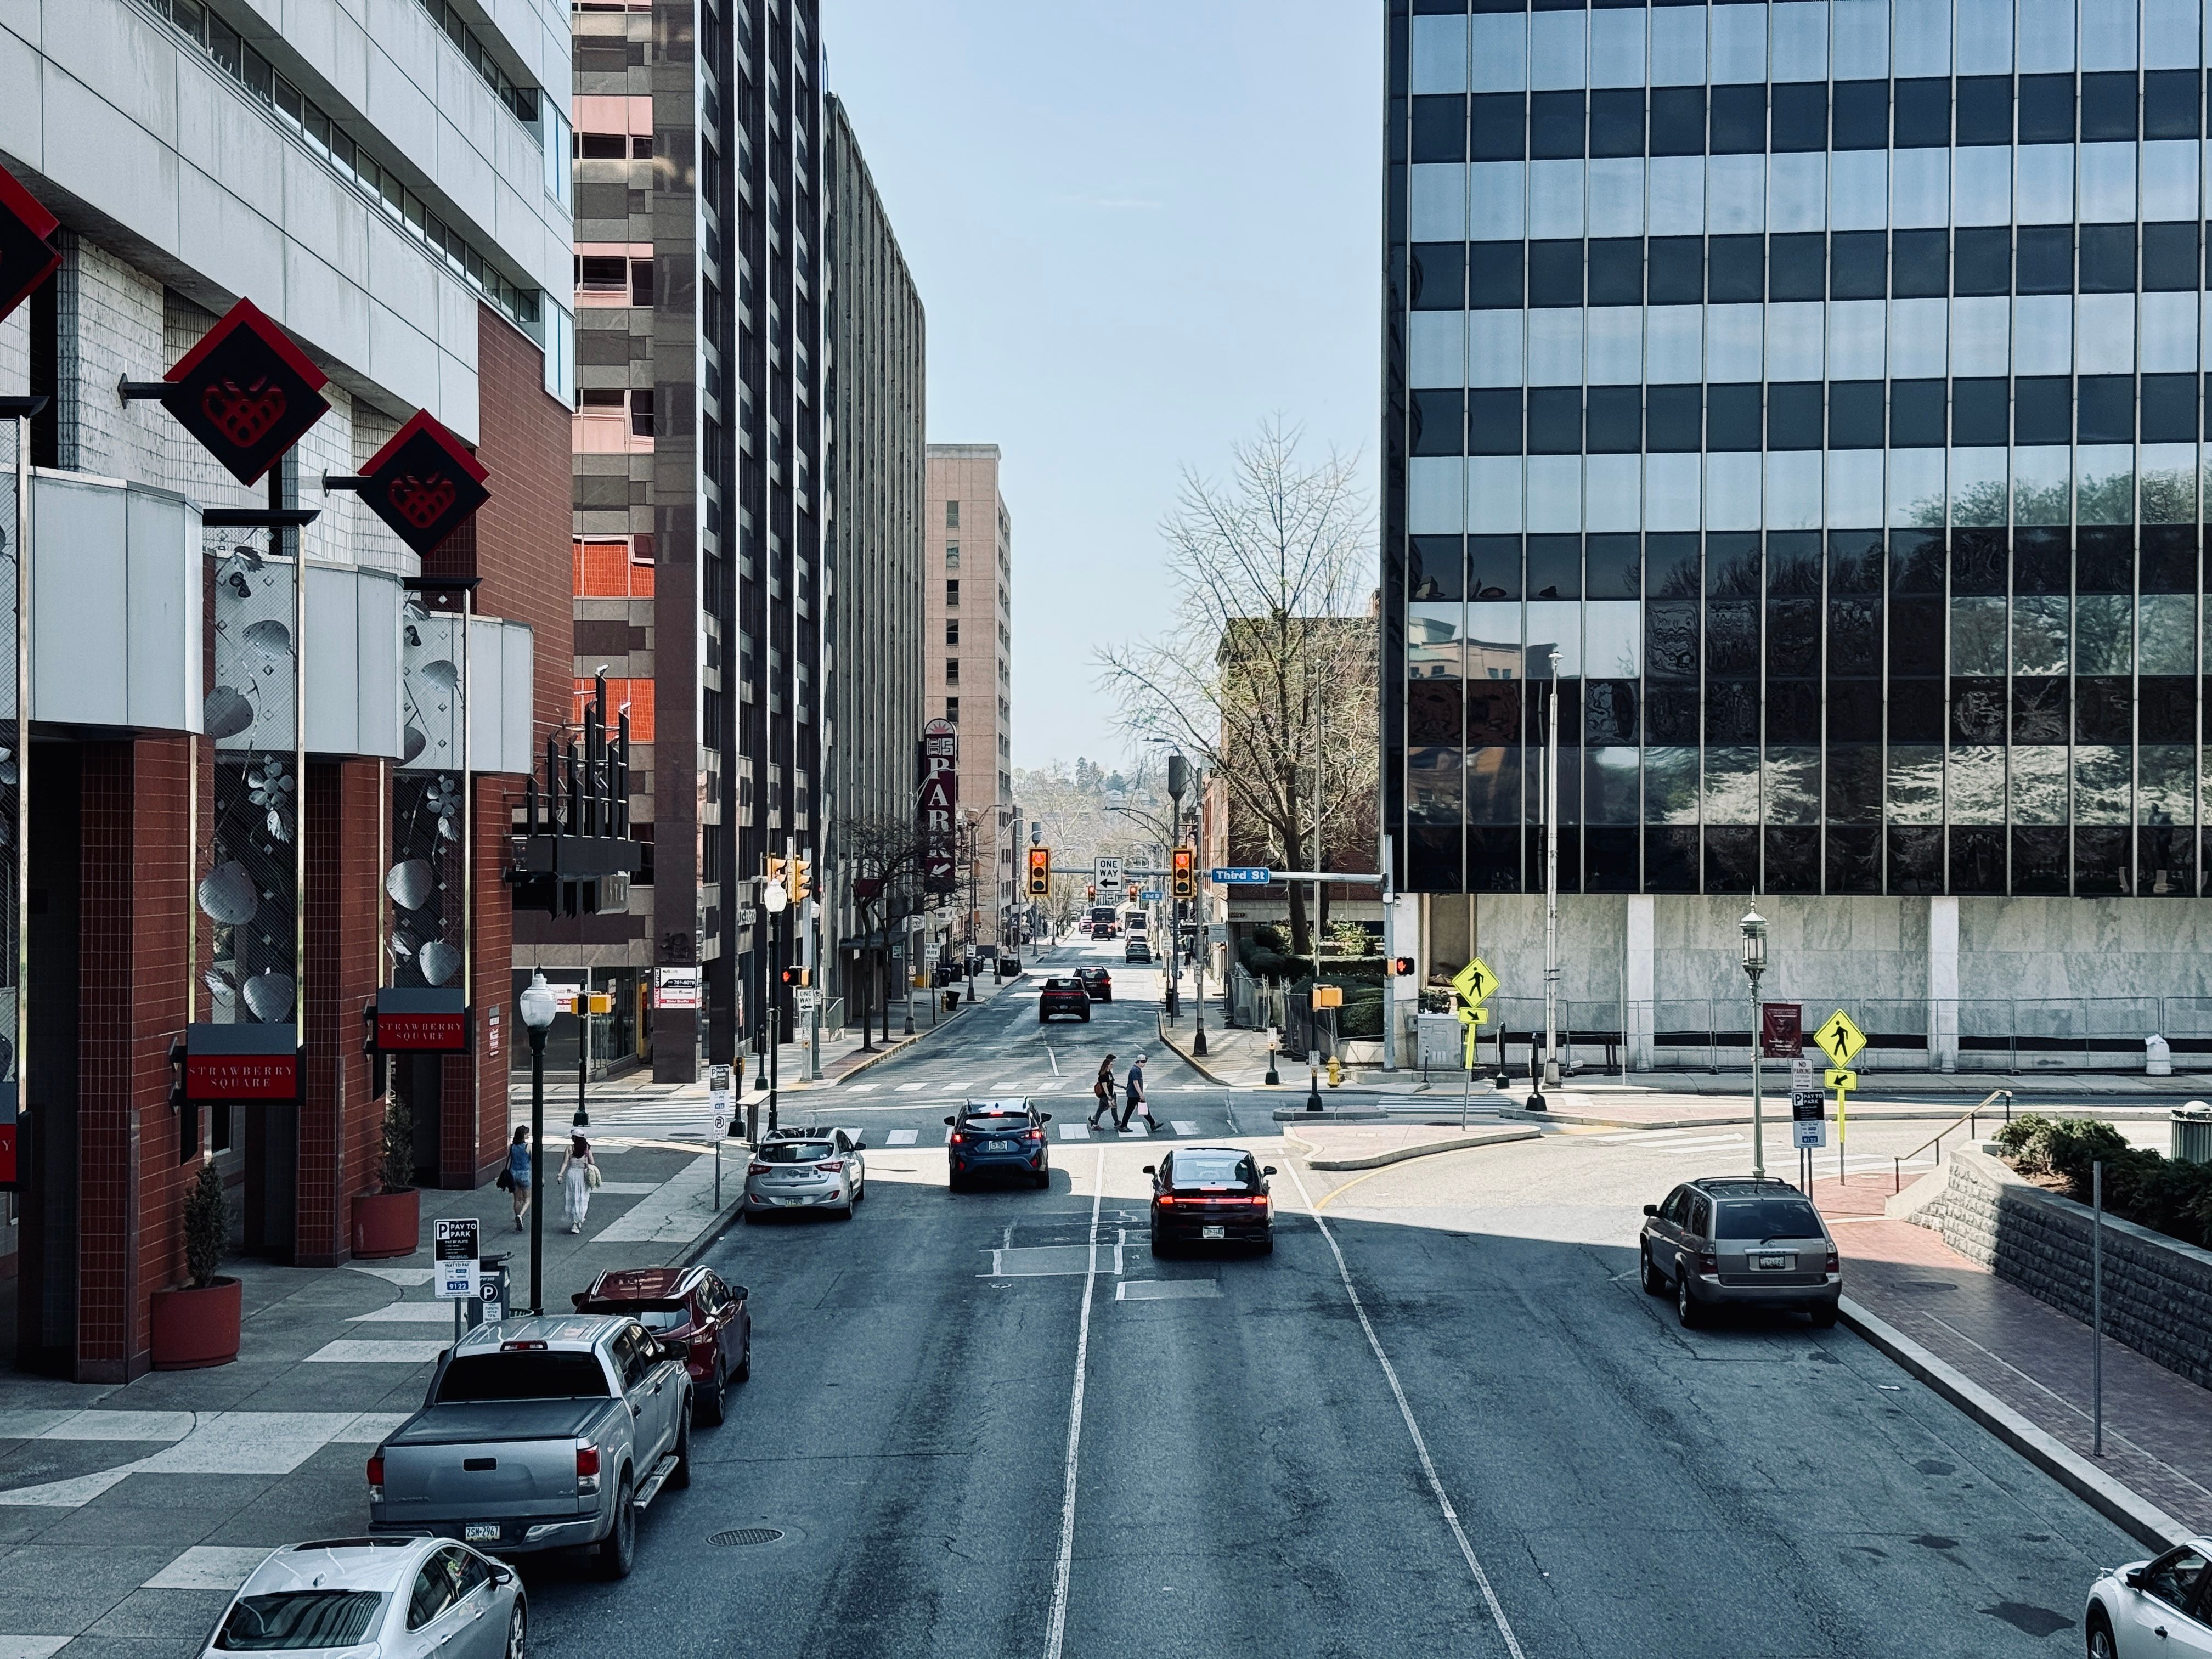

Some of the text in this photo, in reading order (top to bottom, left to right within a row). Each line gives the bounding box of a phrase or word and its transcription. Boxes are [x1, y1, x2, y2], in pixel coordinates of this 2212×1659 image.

[927, 758, 953, 859] PARK
[1100, 860, 1118, 868] ONE
[1099, 869, 1118, 877] WAY
[1216, 870, 1265, 880] Third St
[379, 1023, 461, 1031] STRAWBERRY
[396, 1032, 444, 1041] SQUARE
[188, 1066, 294, 1075] STRAWBERRY
[211, 1078, 271, 1089] SQUARE
[1795, 1094, 1802, 1105] P
[438, 1223, 448, 1238] P
[484, 1286, 494, 1299] P
